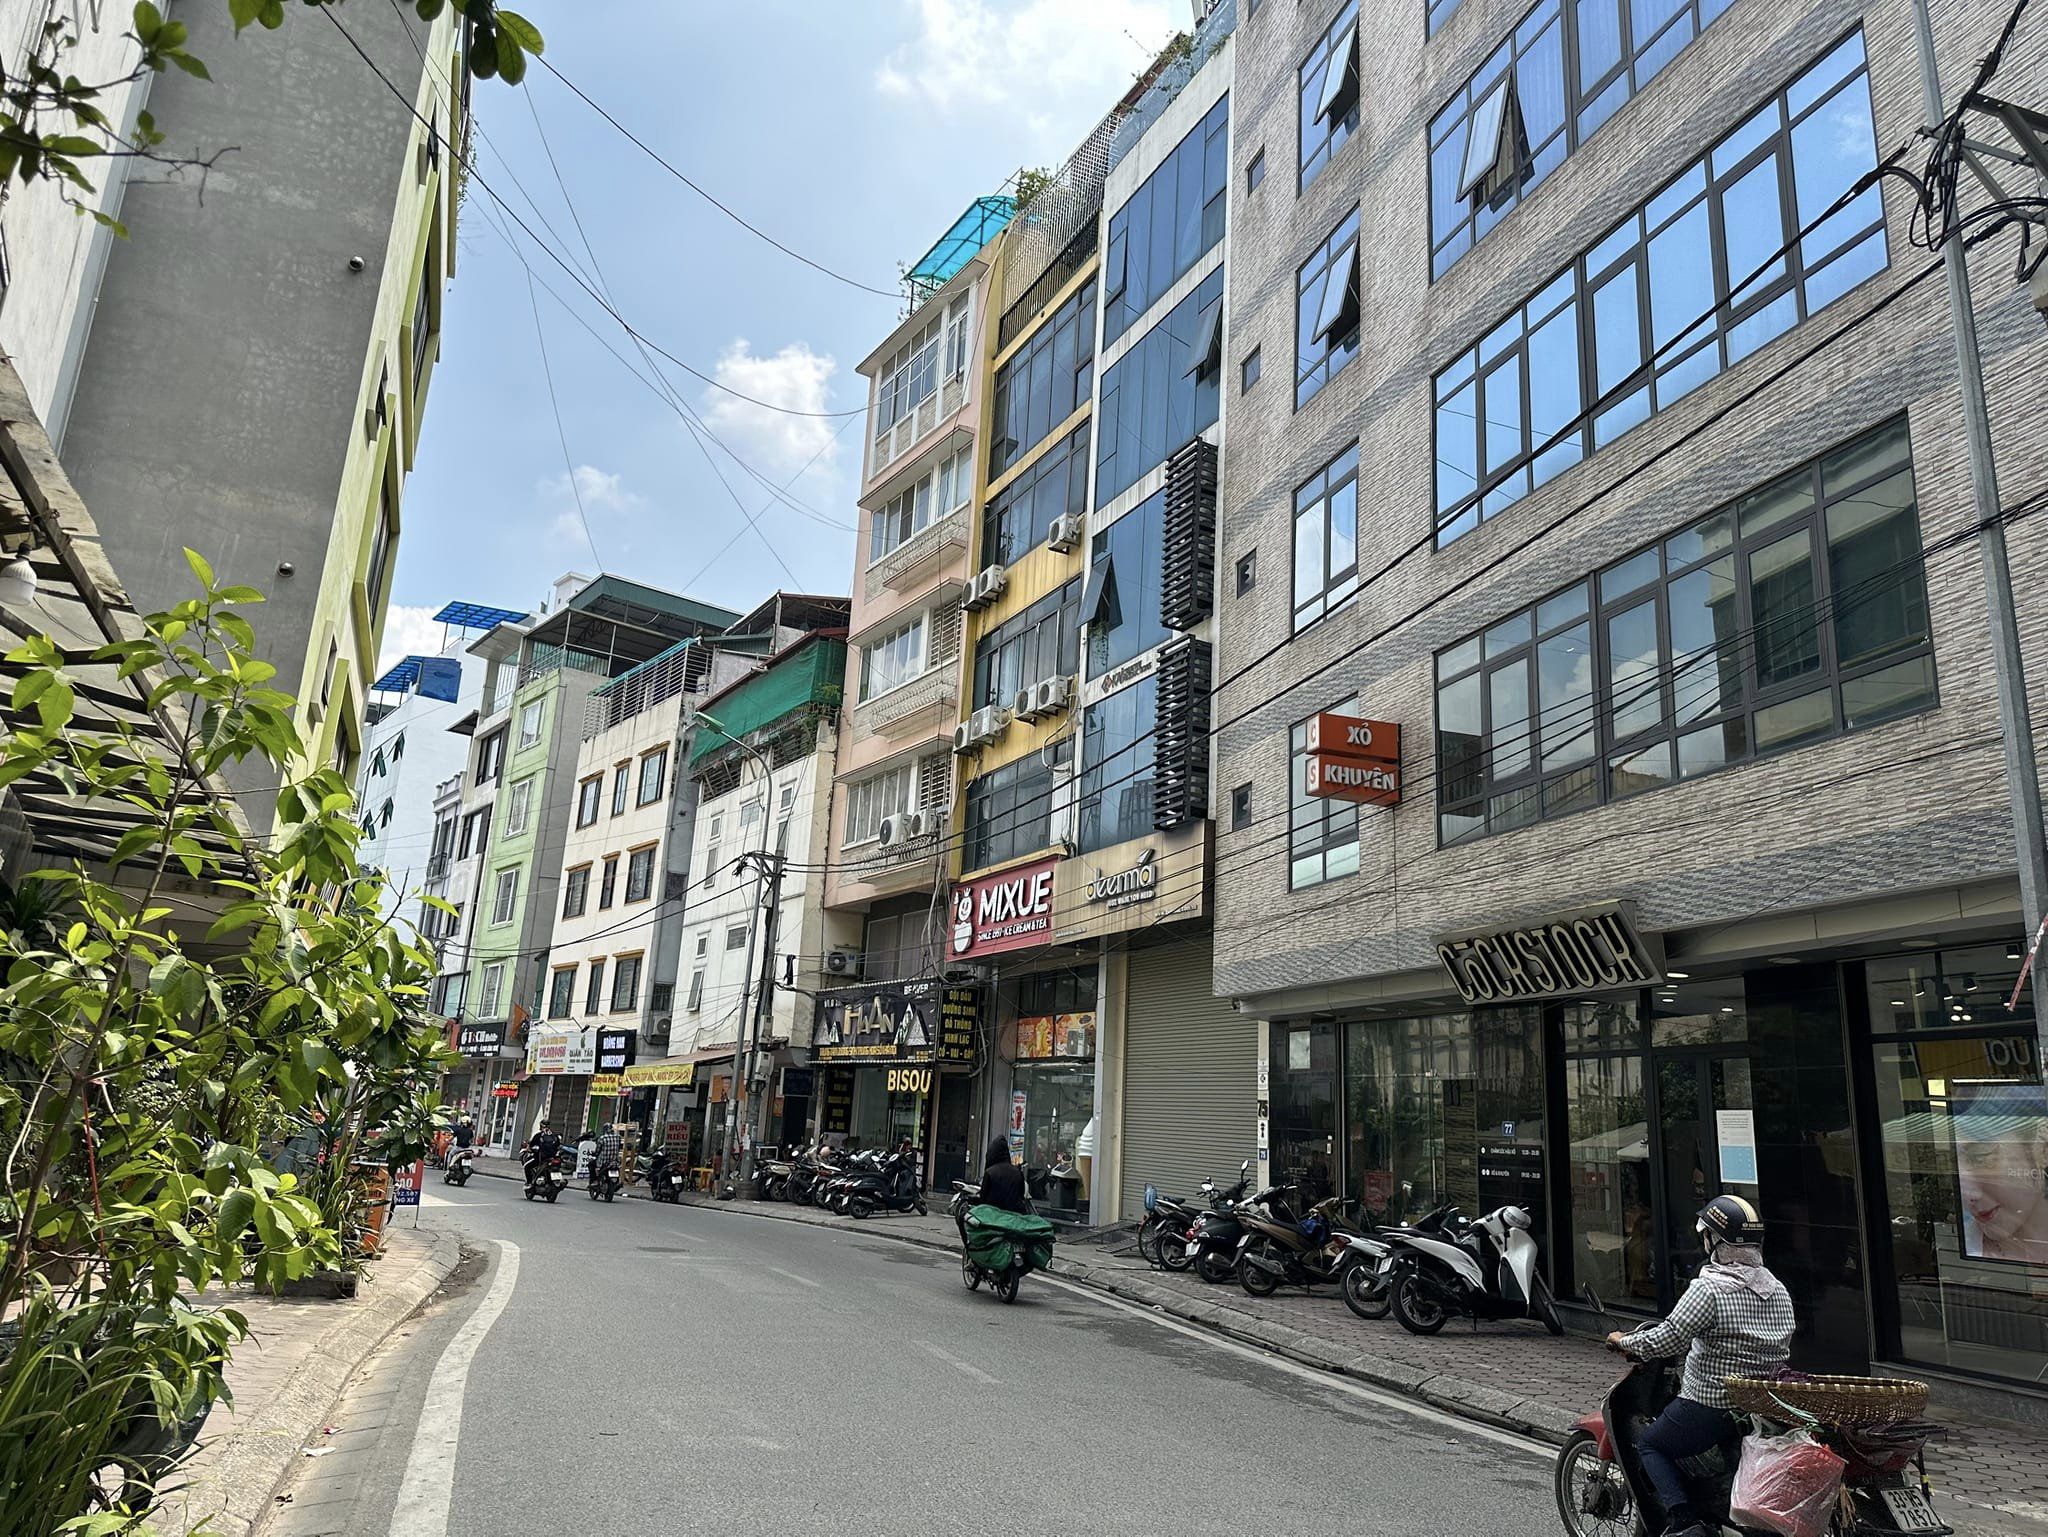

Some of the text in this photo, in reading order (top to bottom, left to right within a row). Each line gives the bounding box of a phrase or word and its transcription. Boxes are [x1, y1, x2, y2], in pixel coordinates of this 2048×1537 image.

[1346, 721, 1372, 745] XỎ
[1324, 764, 1395, 790] KHUYÊN
[978, 870, 1052, 926] MIXUE
[1013, 920, 1032, 935] CREAM
[1036, 917, 1047, 930] TEA
[887, 1068, 932, 1093] BISOU
[1257, 1100, 1268, 1118] 75
[1504, 1123, 1513, 1134] 77
[1898, 1508, 1937, 1528] 7852
